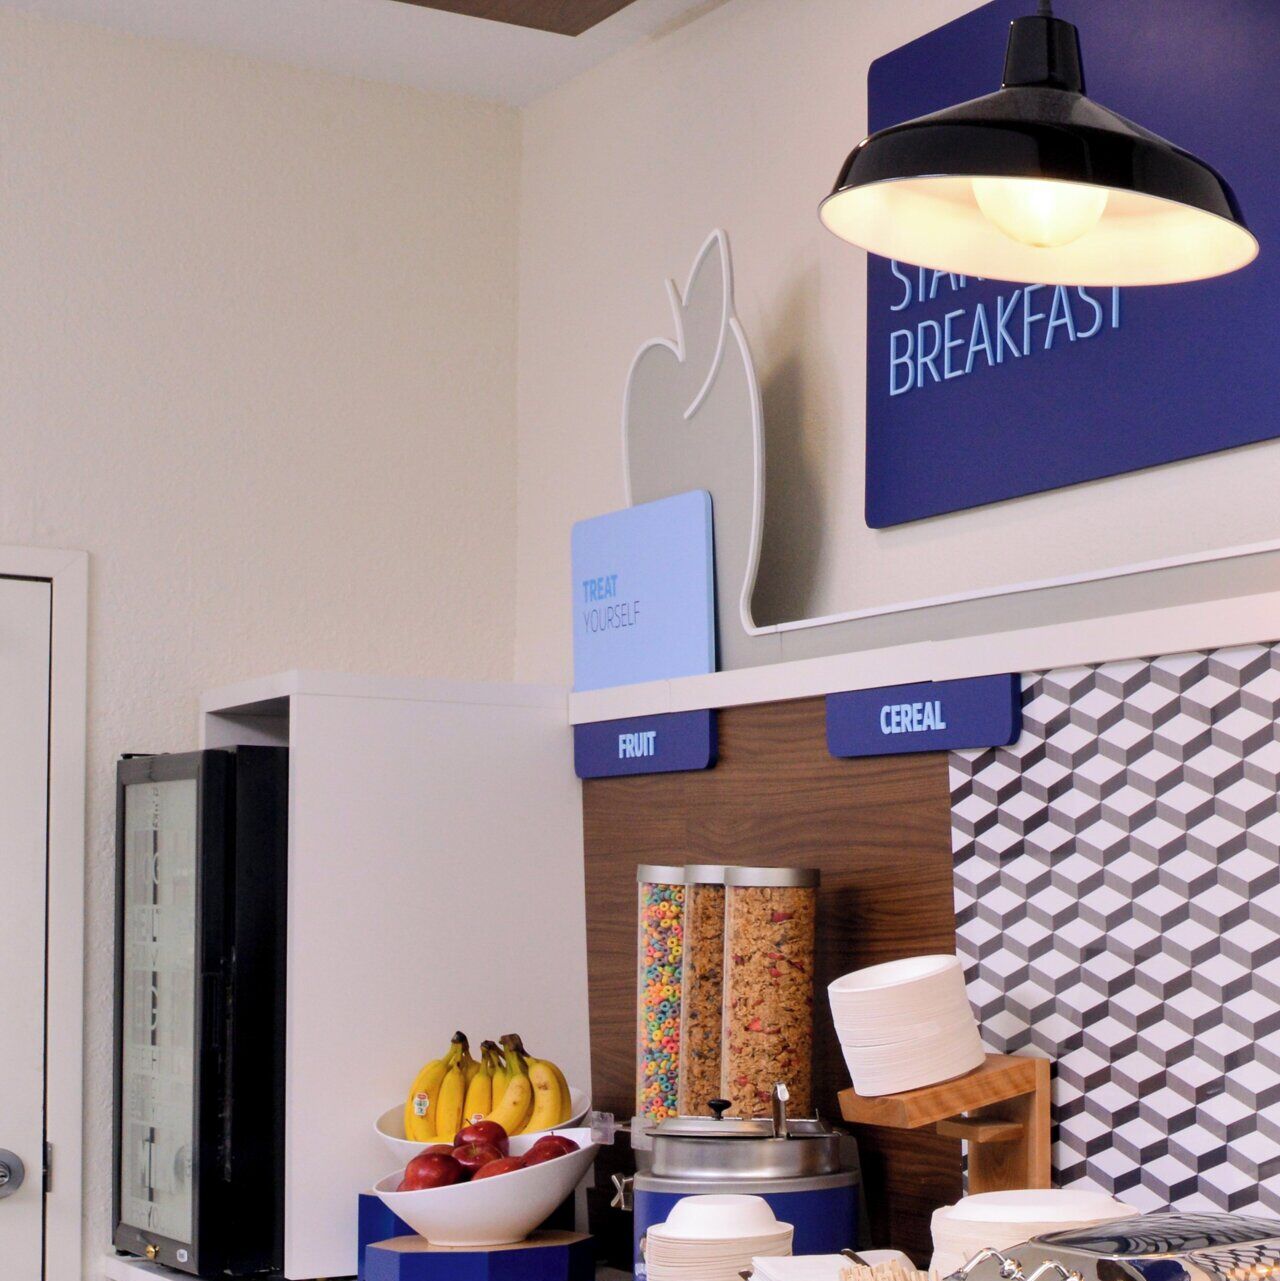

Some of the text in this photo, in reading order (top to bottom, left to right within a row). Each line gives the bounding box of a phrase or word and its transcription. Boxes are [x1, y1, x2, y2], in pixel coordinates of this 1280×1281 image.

[889, 284, 1120, 396] BREAKFAST
[583, 574, 618, 602] TREAT
[583, 600, 640, 633] YOURSELF
[880, 700, 946, 735] CEREAL
[618, 731, 656, 759] FRUIT
